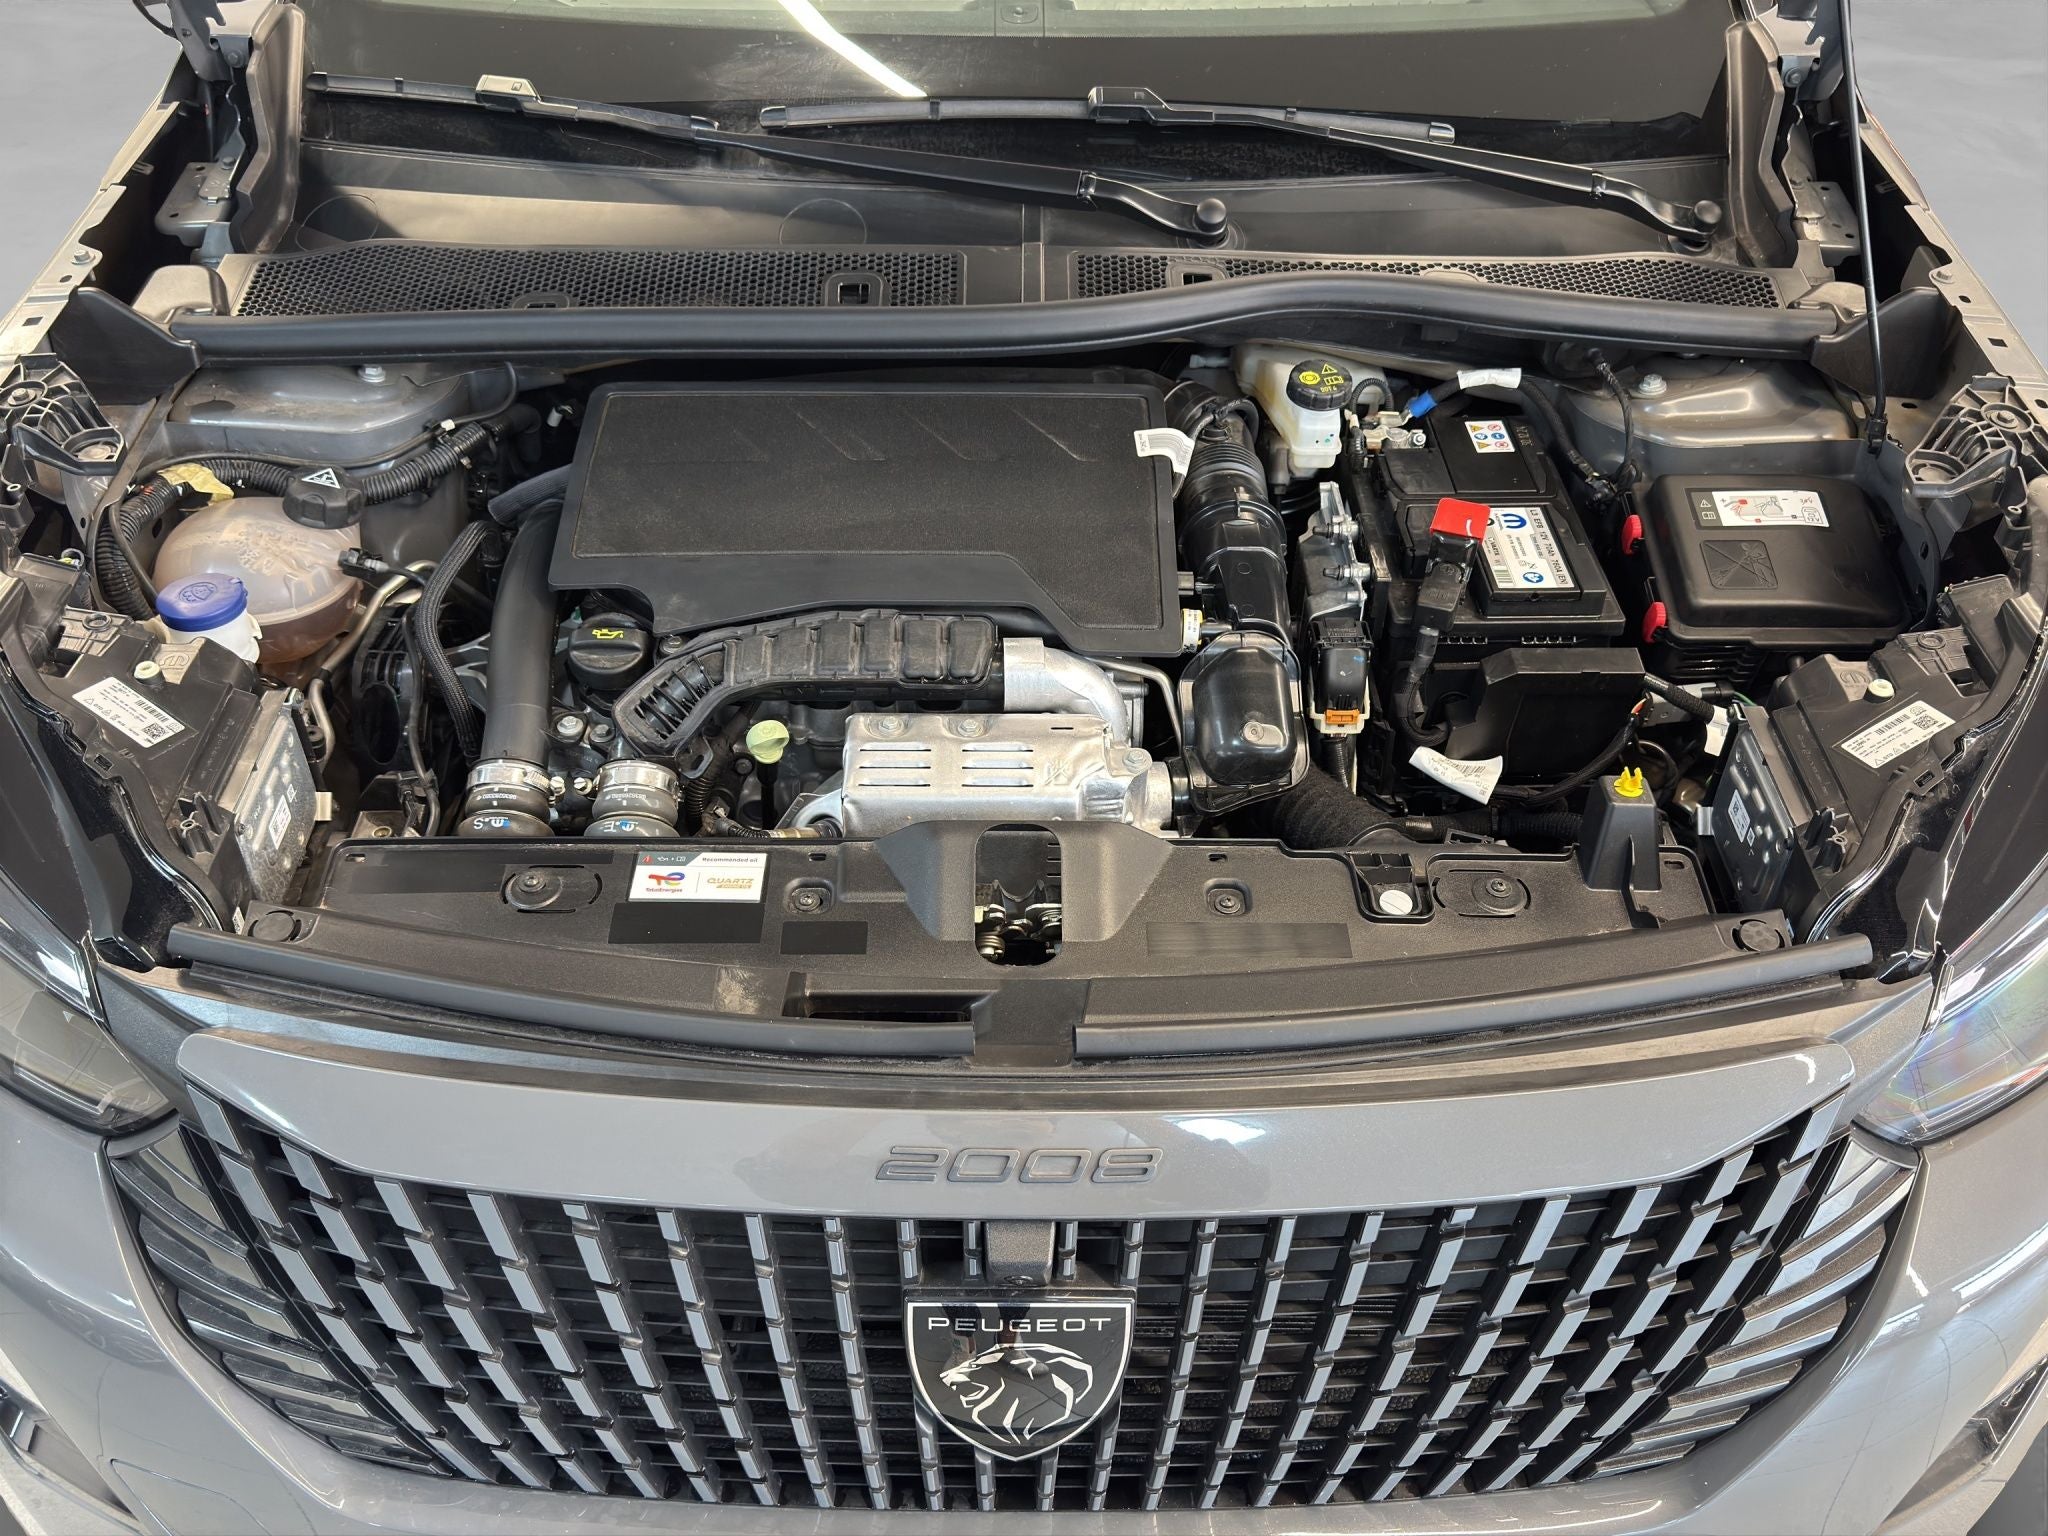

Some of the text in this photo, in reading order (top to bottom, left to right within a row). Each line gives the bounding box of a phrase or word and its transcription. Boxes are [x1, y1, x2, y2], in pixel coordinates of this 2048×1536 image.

[1540, 531, 1549, 541] 12V
[1545, 543, 1555, 557] 70Ah
[875, 1145, 1164, 1184] 2008
[928, 1317, 1113, 1332] PEUGEOT
